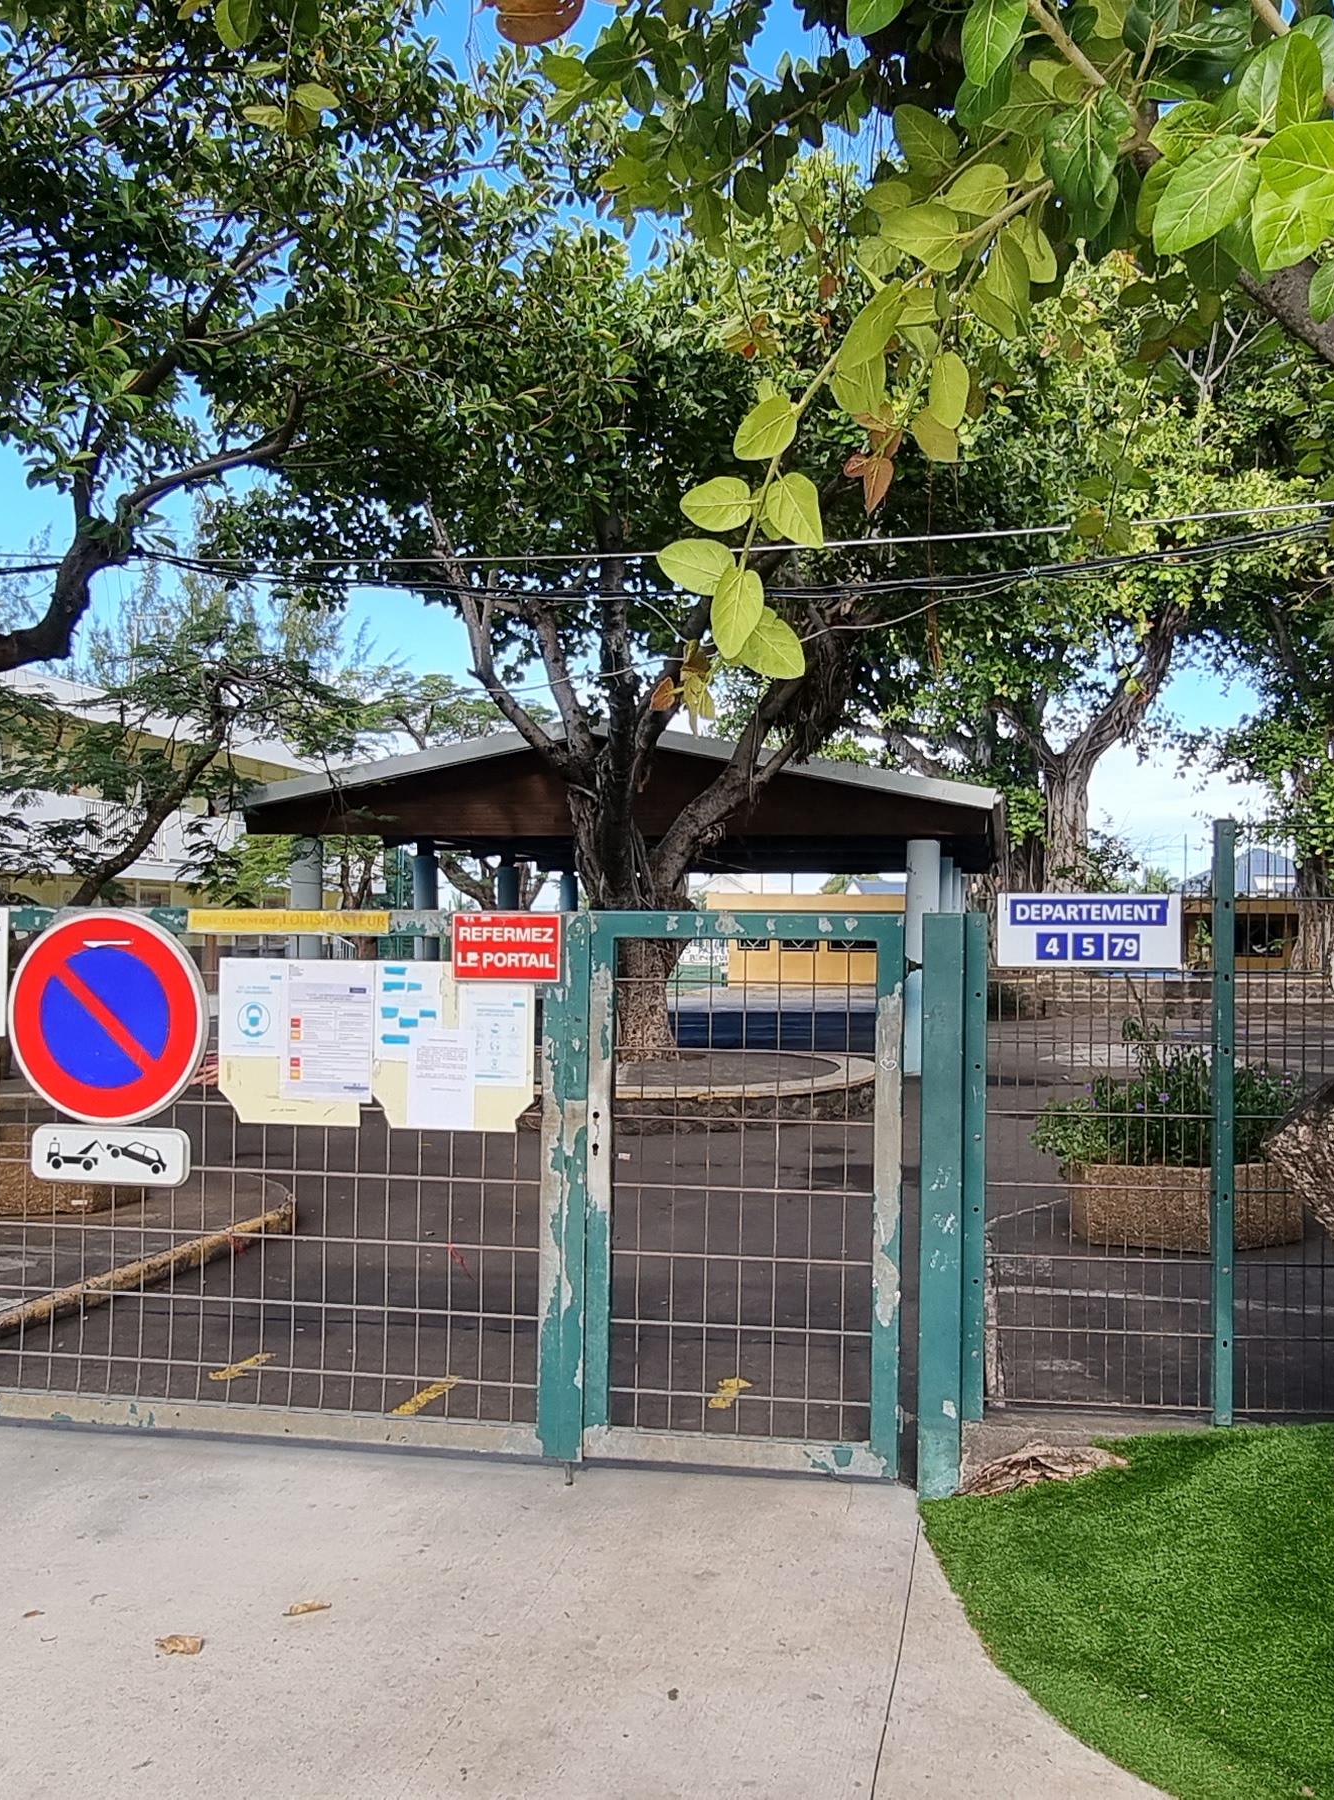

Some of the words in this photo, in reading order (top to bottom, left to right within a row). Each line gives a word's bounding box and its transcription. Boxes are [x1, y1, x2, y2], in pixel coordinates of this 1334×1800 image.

[282, 914, 320, 927] LOUIS
[325, 914, 386, 927] PASTEUR
[1016, 903, 1161, 921] DEPARTEMENT
[458, 926, 555, 943] REFERMEZ
[1045, 937, 1060, 956] 4
[1081, 937, 1095, 956] 5
[1111, 938, 1138, 957] 79
[457, 952, 478, 967] LE
[482, 952, 556, 968] PORTAIL
